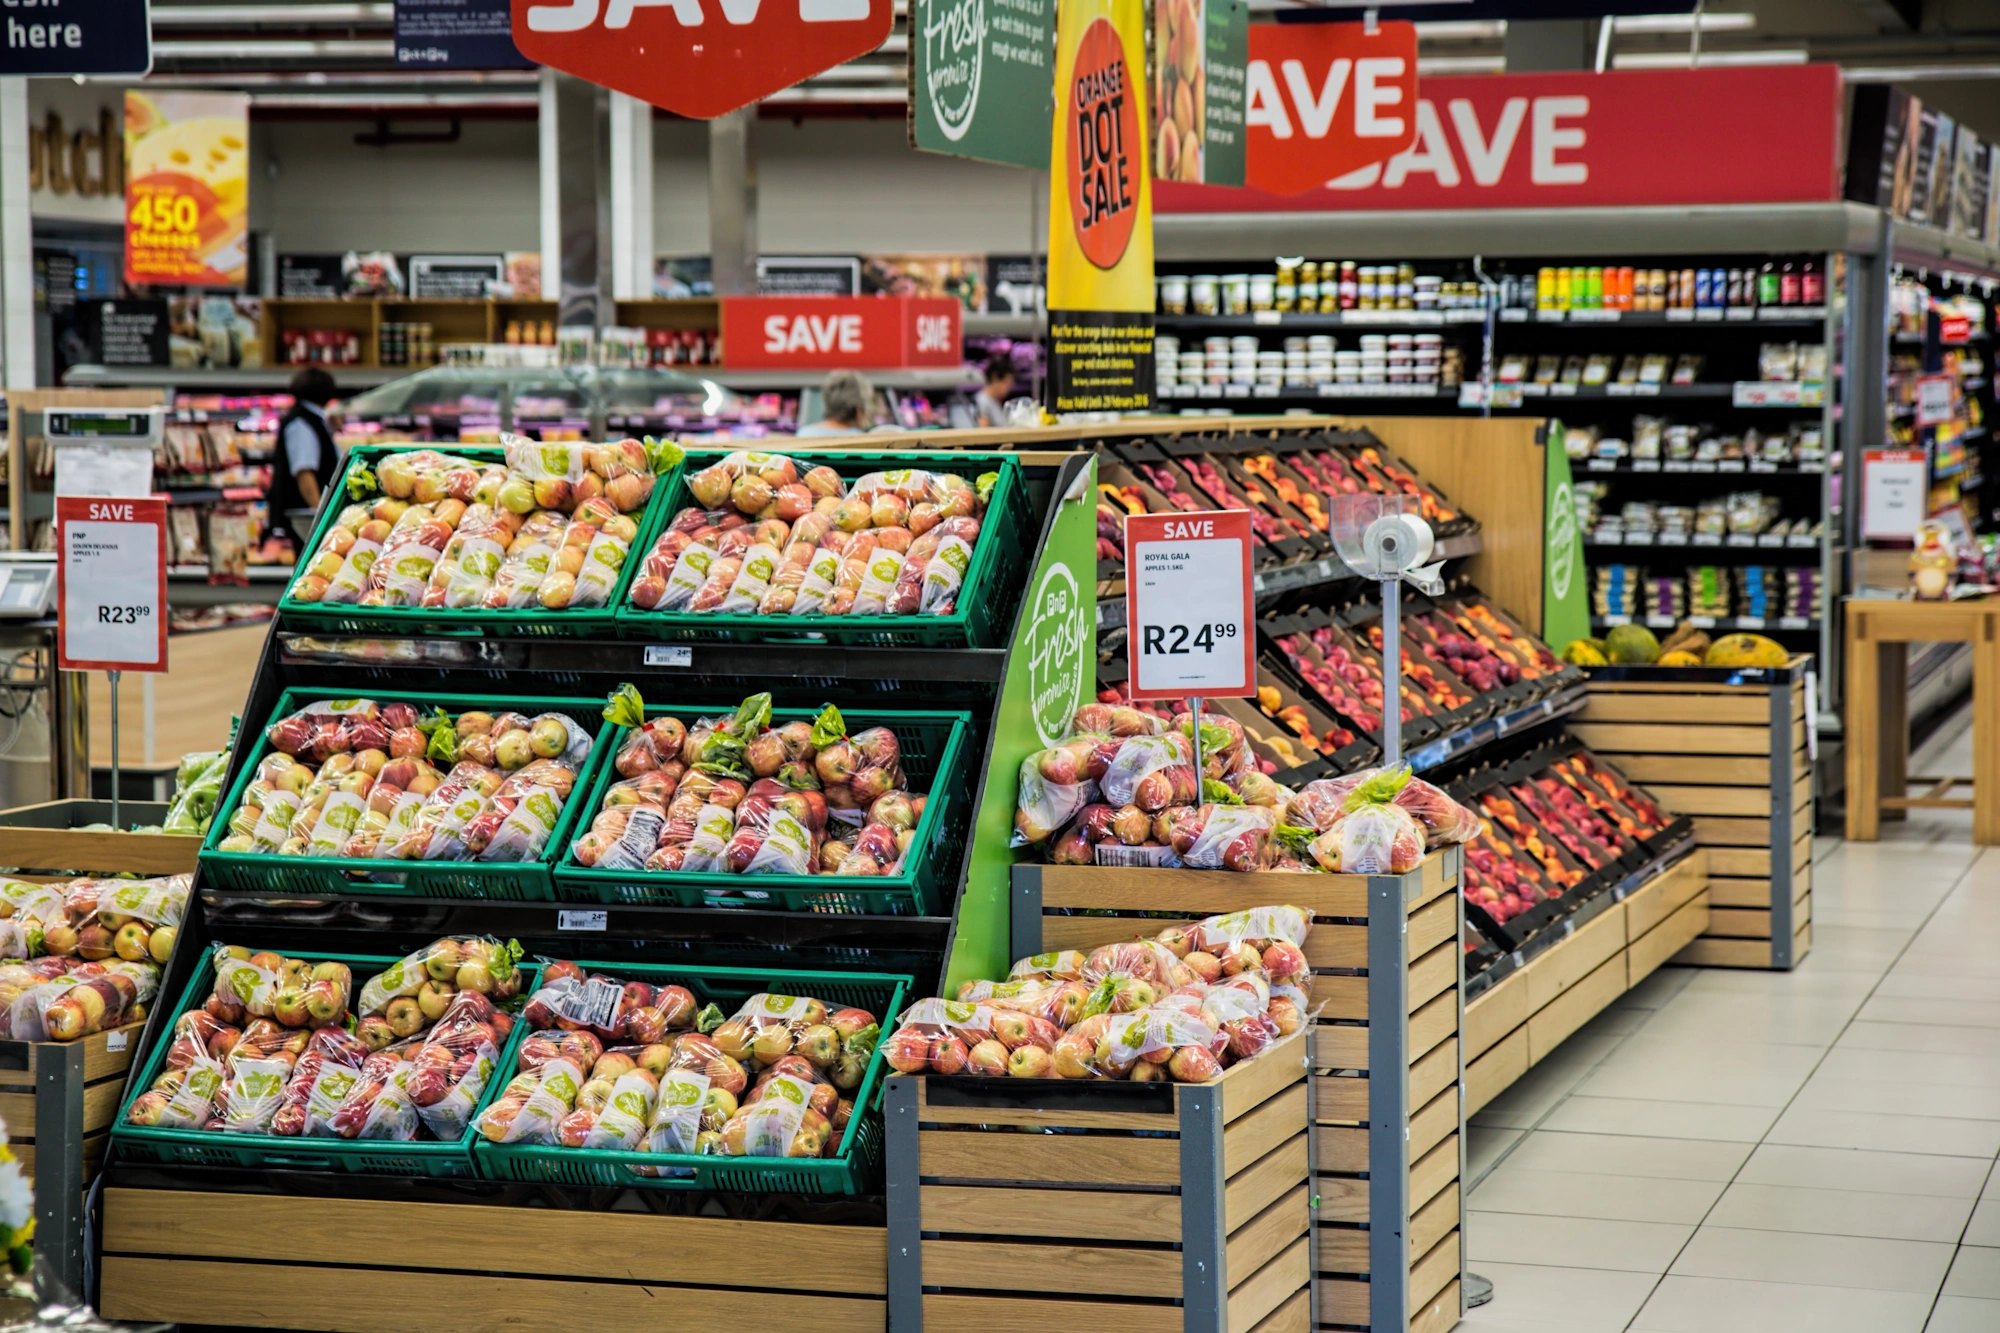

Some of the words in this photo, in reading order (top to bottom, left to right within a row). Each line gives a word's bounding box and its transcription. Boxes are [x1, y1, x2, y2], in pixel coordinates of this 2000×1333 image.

[8, 16, 82, 48] here
[1076, 61, 1123, 112] ORANGE
[1077, 94, 1124, 175] DOT
[1080, 156, 1132, 232] SALE
[129, 195, 199, 233] 450
[764, 315, 863, 353] SAVE
[916, 314, 951, 353] SAVE
[89, 503, 134, 521] SAVE
[1164, 520, 1214, 539] SAVE
[72, 532, 86, 540] PNP
[1145, 553, 1168, 561] ROYAL
[1170, 552, 1190, 561] GALA
[1047, 590, 1067, 617] PnP
[1024, 581, 1089, 683] Fresh
[1036, 671, 1071, 731] promise
